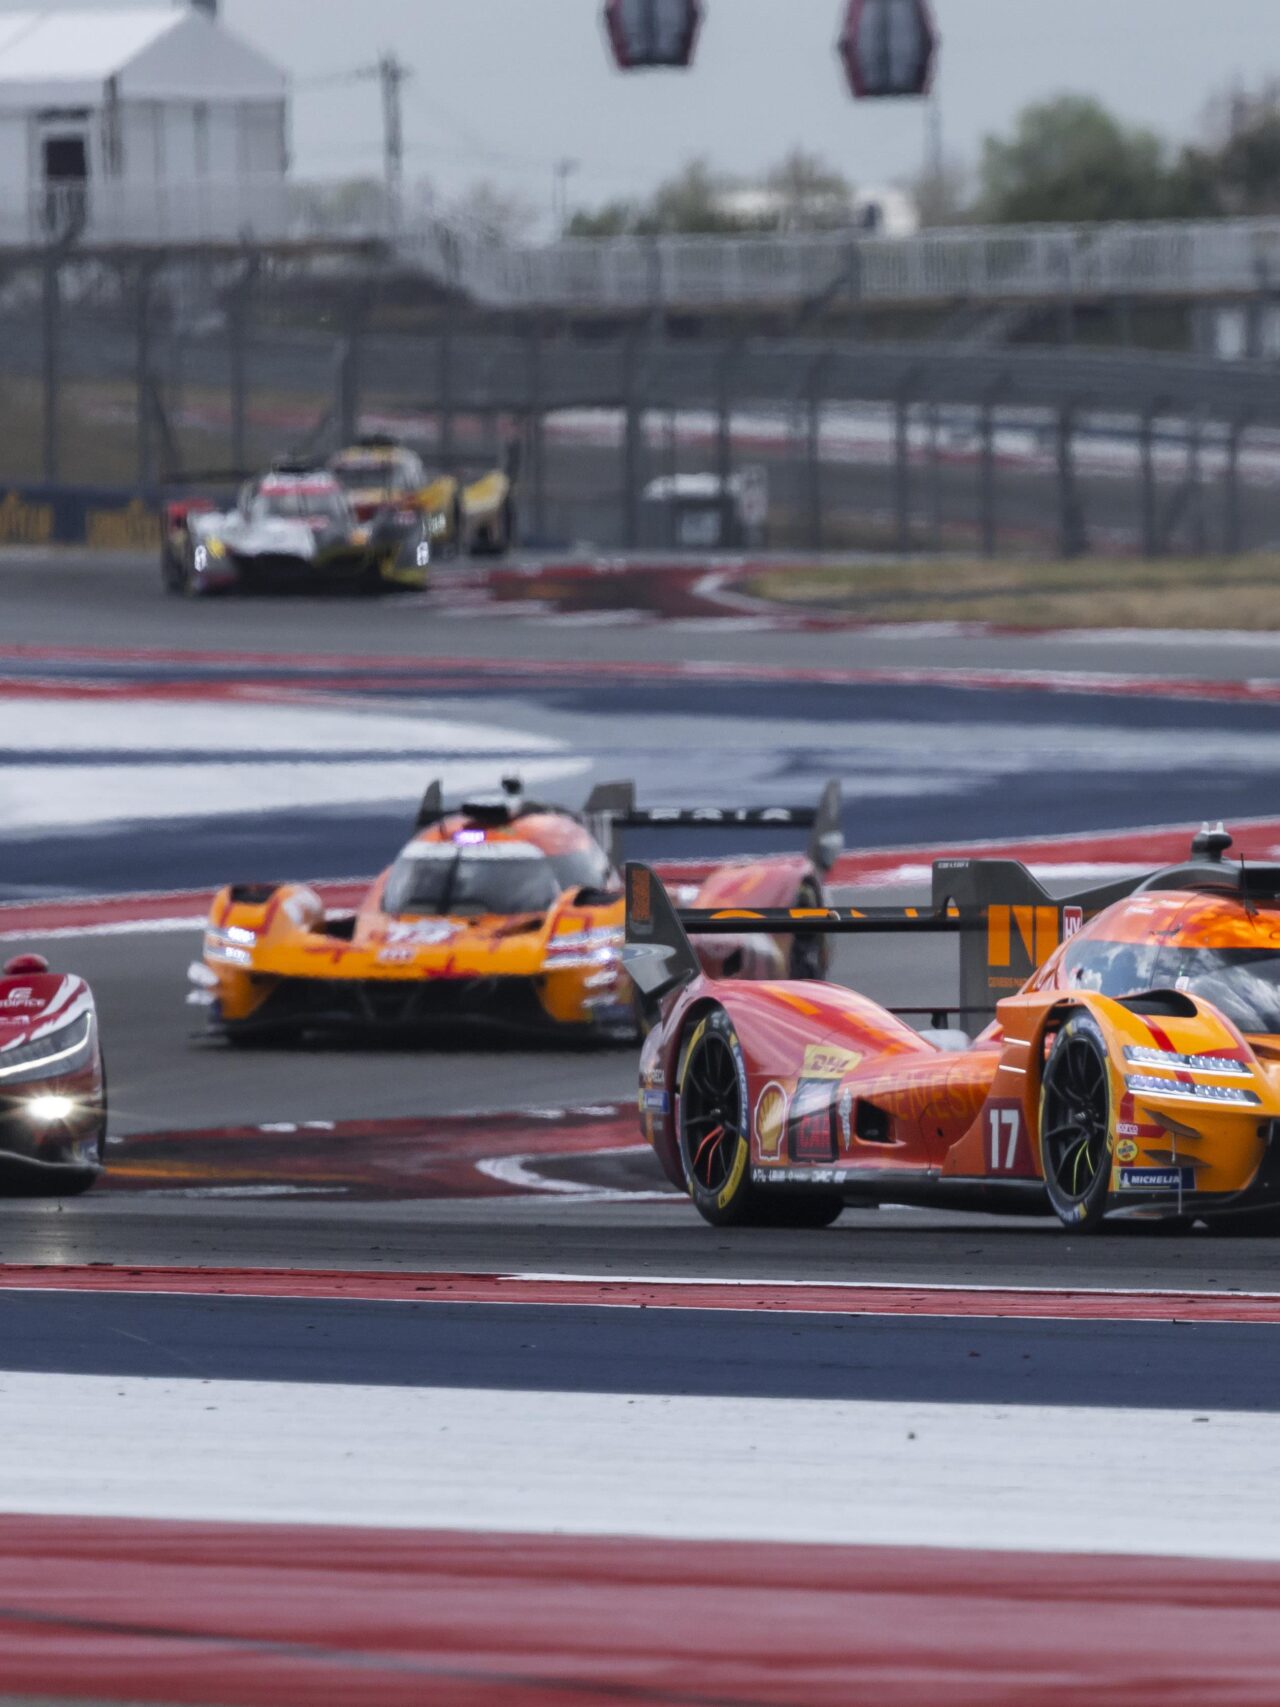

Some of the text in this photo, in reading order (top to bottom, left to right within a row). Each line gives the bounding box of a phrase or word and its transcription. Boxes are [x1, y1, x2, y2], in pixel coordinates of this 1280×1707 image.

[811, 1054, 849, 1073] DHL
[989, 1109, 1019, 1169] 17
[1131, 1175, 1180, 1185] MICHELIN
